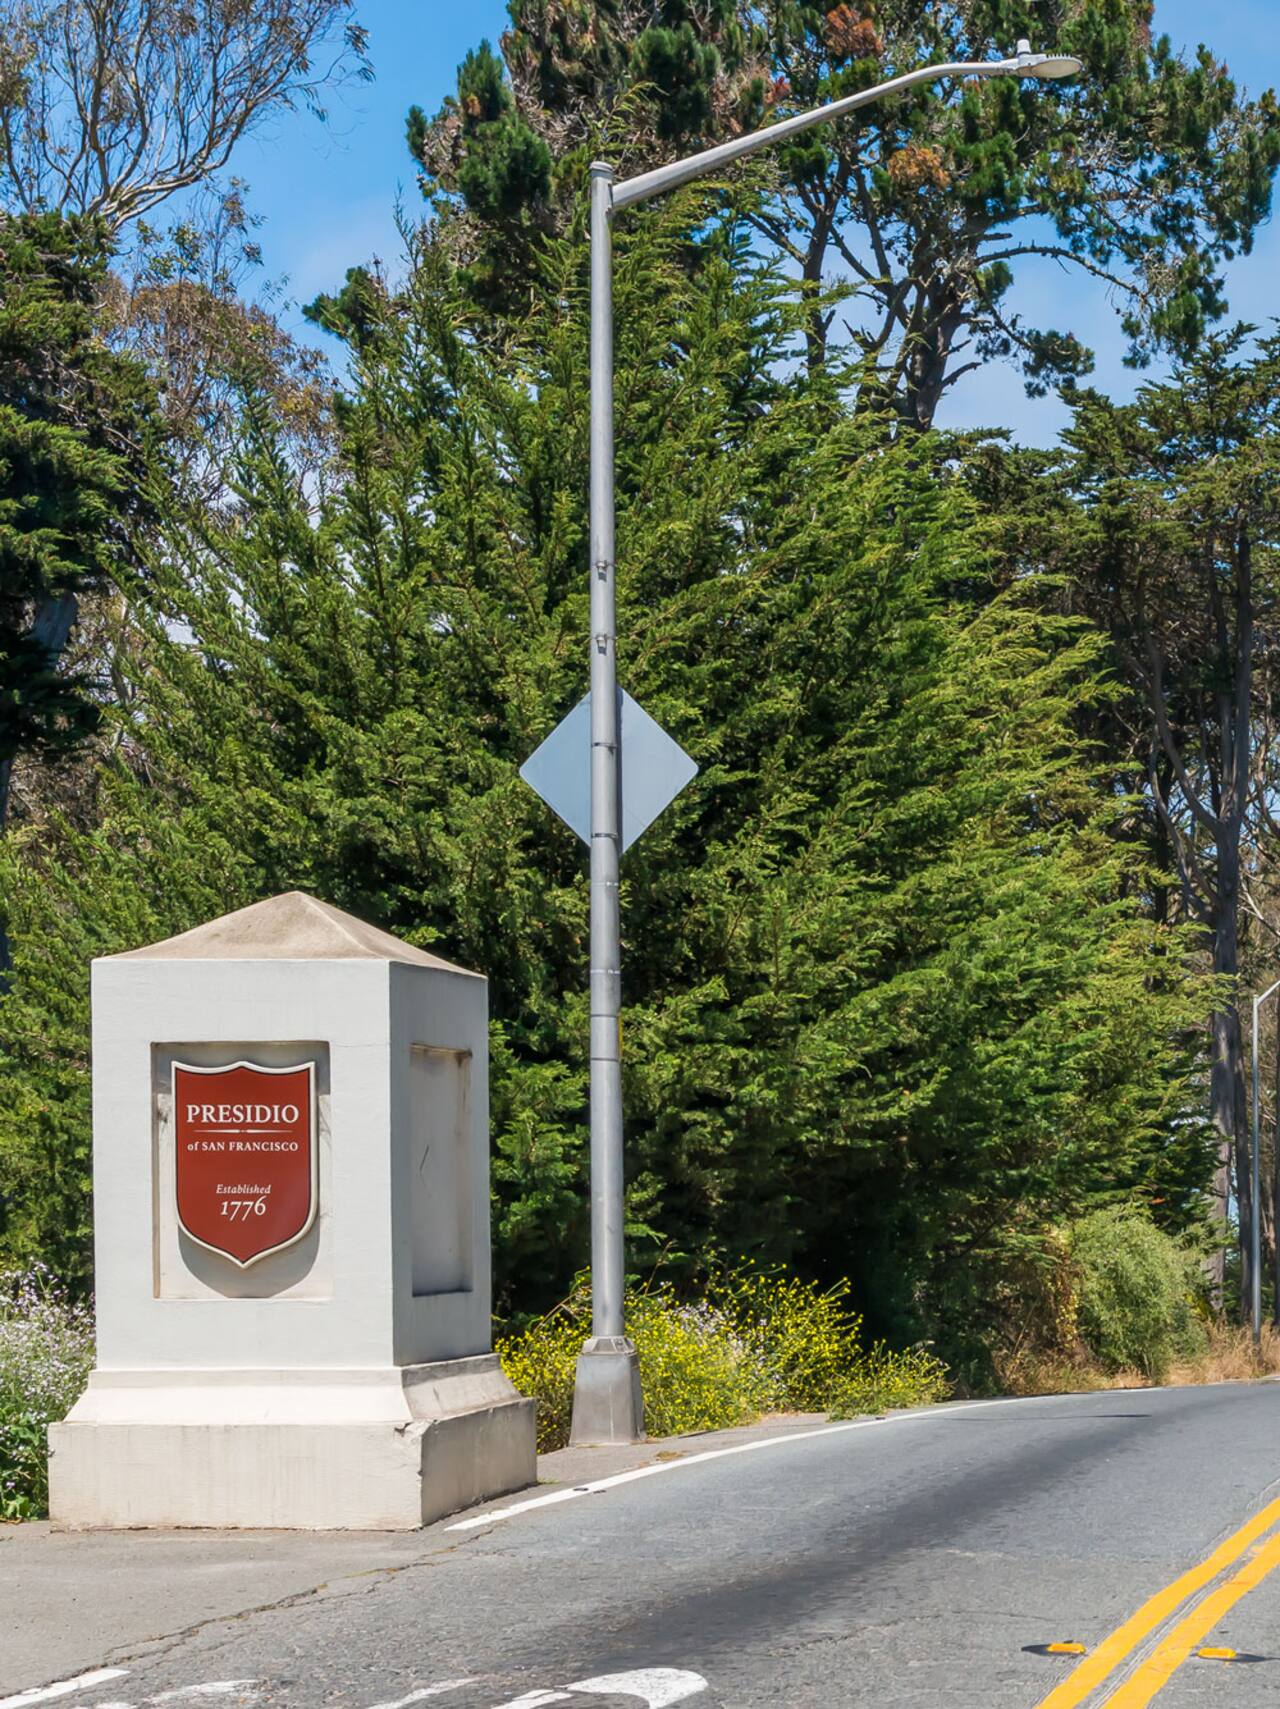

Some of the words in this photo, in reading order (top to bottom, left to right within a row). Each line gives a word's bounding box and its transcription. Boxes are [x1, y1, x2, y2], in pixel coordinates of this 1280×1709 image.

[186, 1104, 300, 1124] PRESIDIO
[187, 1141, 200, 1152] of
[201, 1141, 227, 1152] SAN
[228, 1141, 299, 1152] FRANCISCO
[215, 1183, 272, 1195] Established
[220, 1195, 267, 1222] 1776
